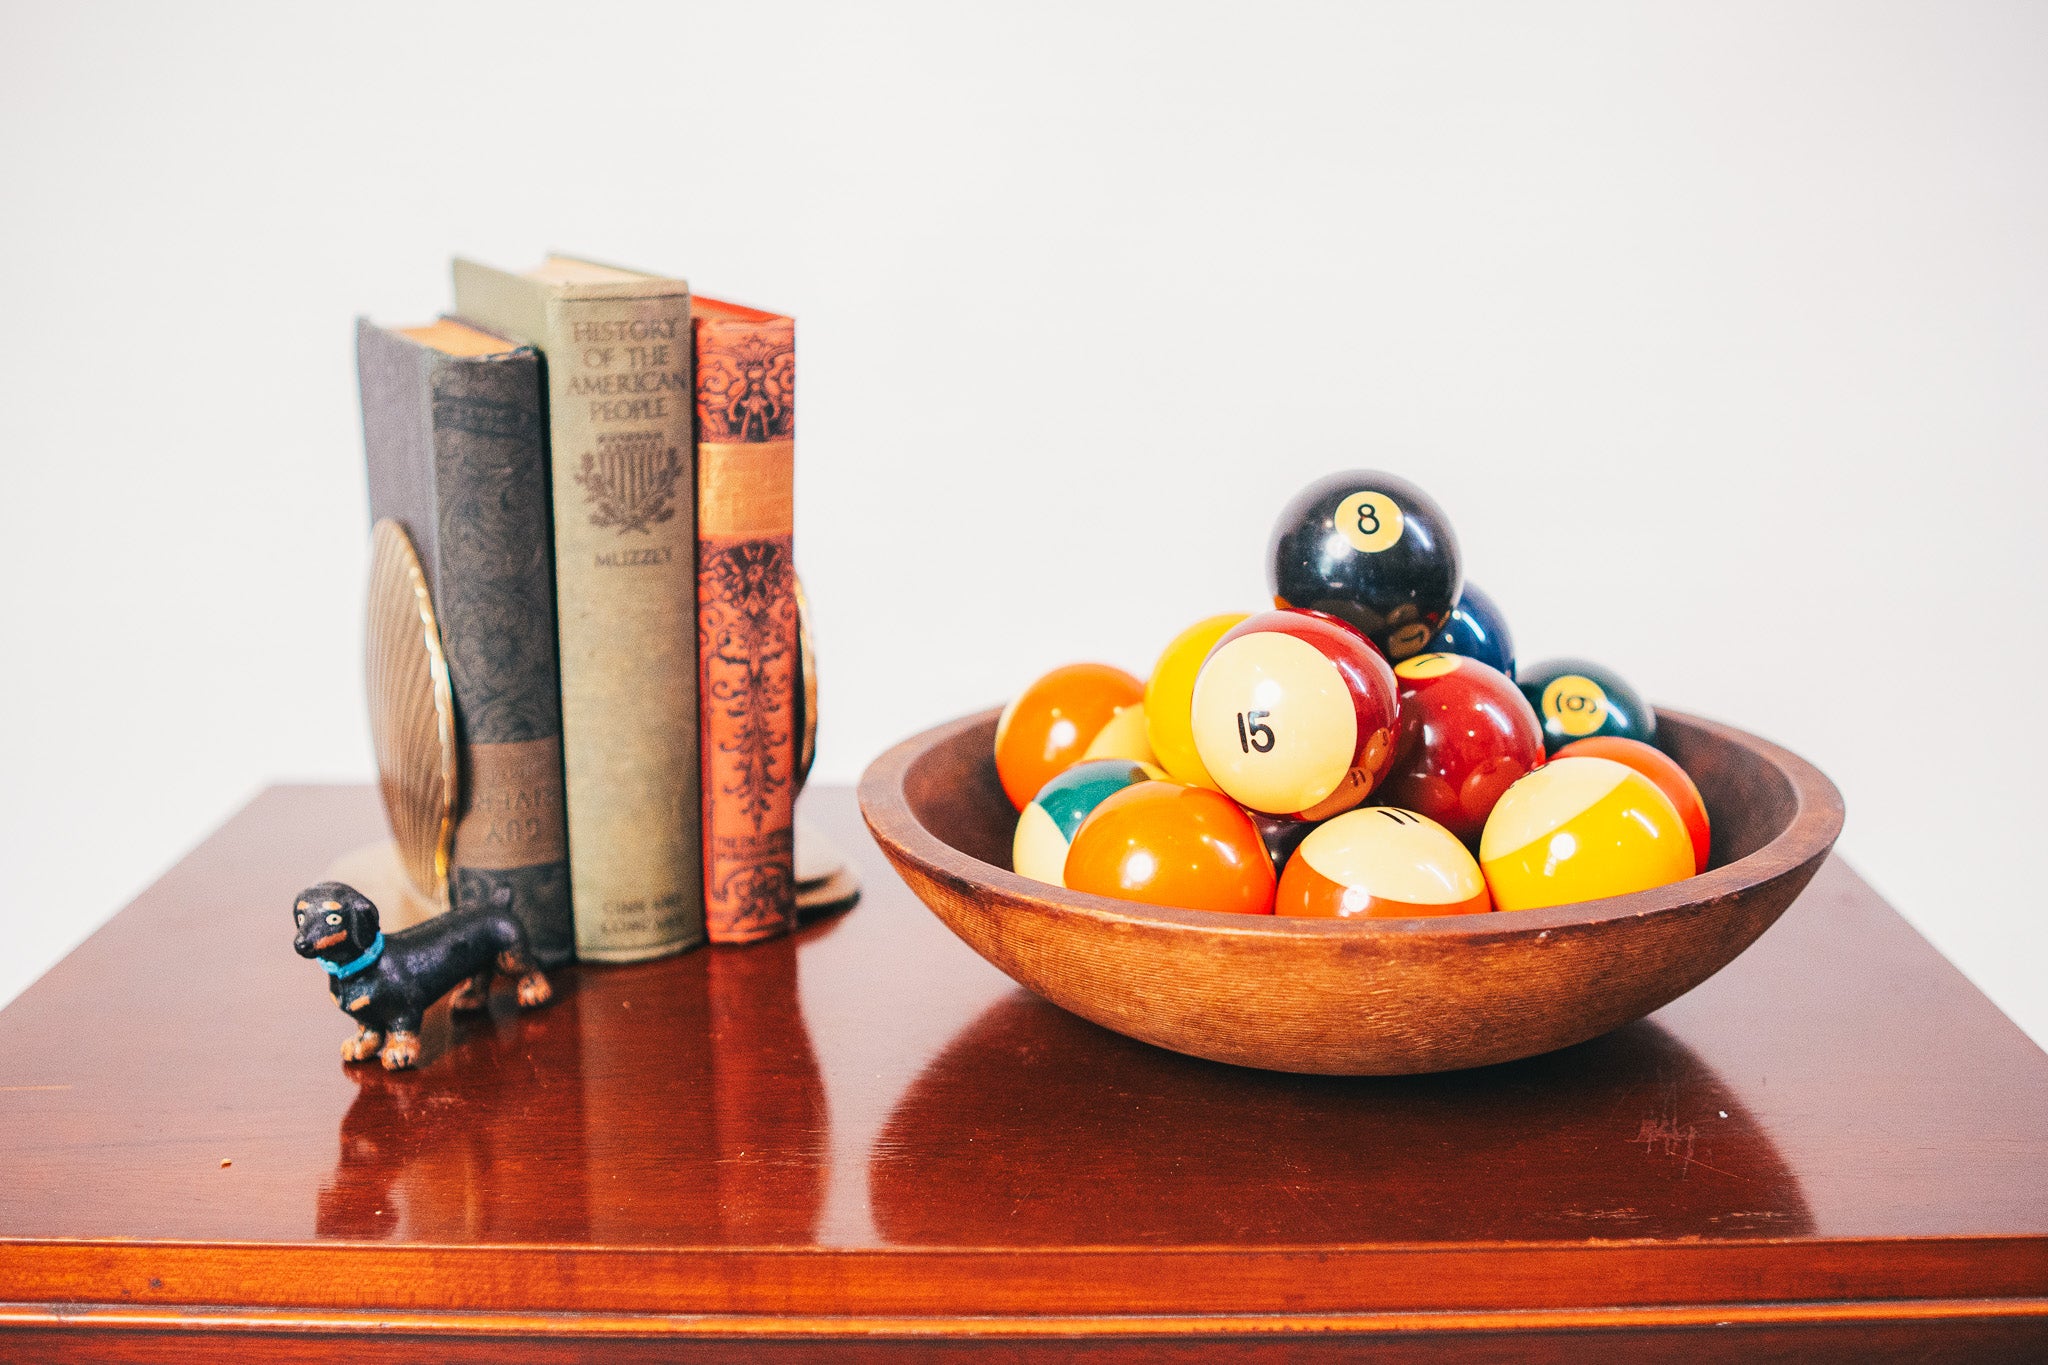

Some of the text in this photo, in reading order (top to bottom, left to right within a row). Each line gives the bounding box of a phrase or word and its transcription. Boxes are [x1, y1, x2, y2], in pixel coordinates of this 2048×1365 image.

[572, 317, 679, 343] HISTORY
[583, 344, 670, 369] OF THE
[567, 371, 687, 396] AMERICAN
[589, 396, 668, 422] PEOPLE
[1357, 503, 1380, 535] 8
[593, 546, 673, 568] MUZZEY
[1237, 710, 1276, 754] 15
[1376, 807, 1420, 825] 11
[485, 817, 542, 846] GUY
